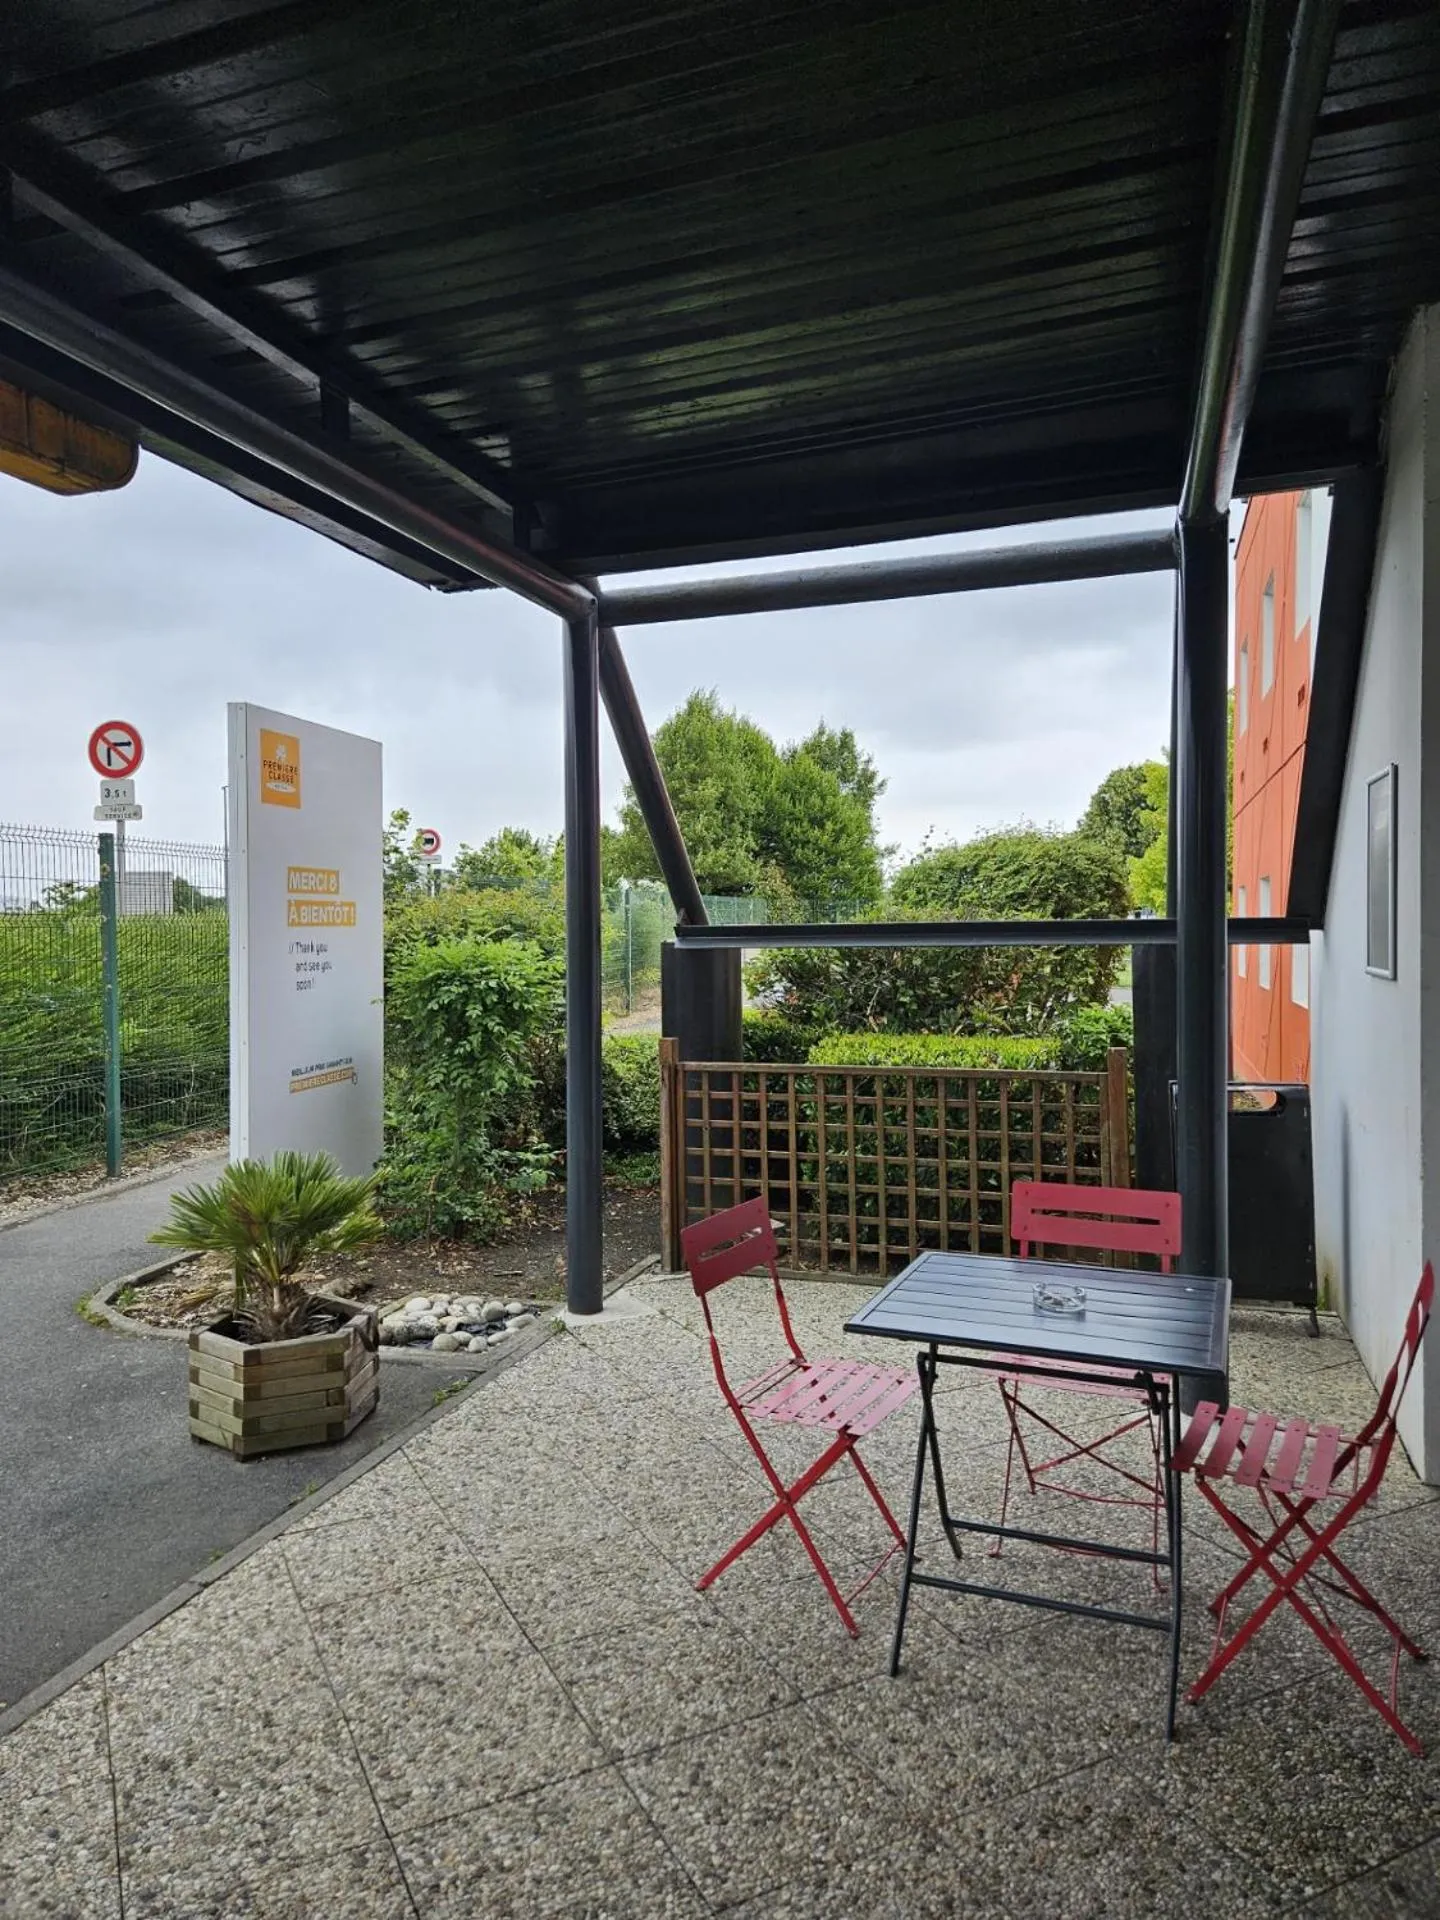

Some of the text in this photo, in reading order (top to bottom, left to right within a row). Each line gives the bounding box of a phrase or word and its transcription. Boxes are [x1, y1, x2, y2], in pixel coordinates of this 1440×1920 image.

[268, 770, 294, 784] CLASSE
[289, 871, 338, 892] MERCI &
[288, 899, 298, 924] À
[316, 943, 328, 956] you
[295, 961, 333, 973] and see you
